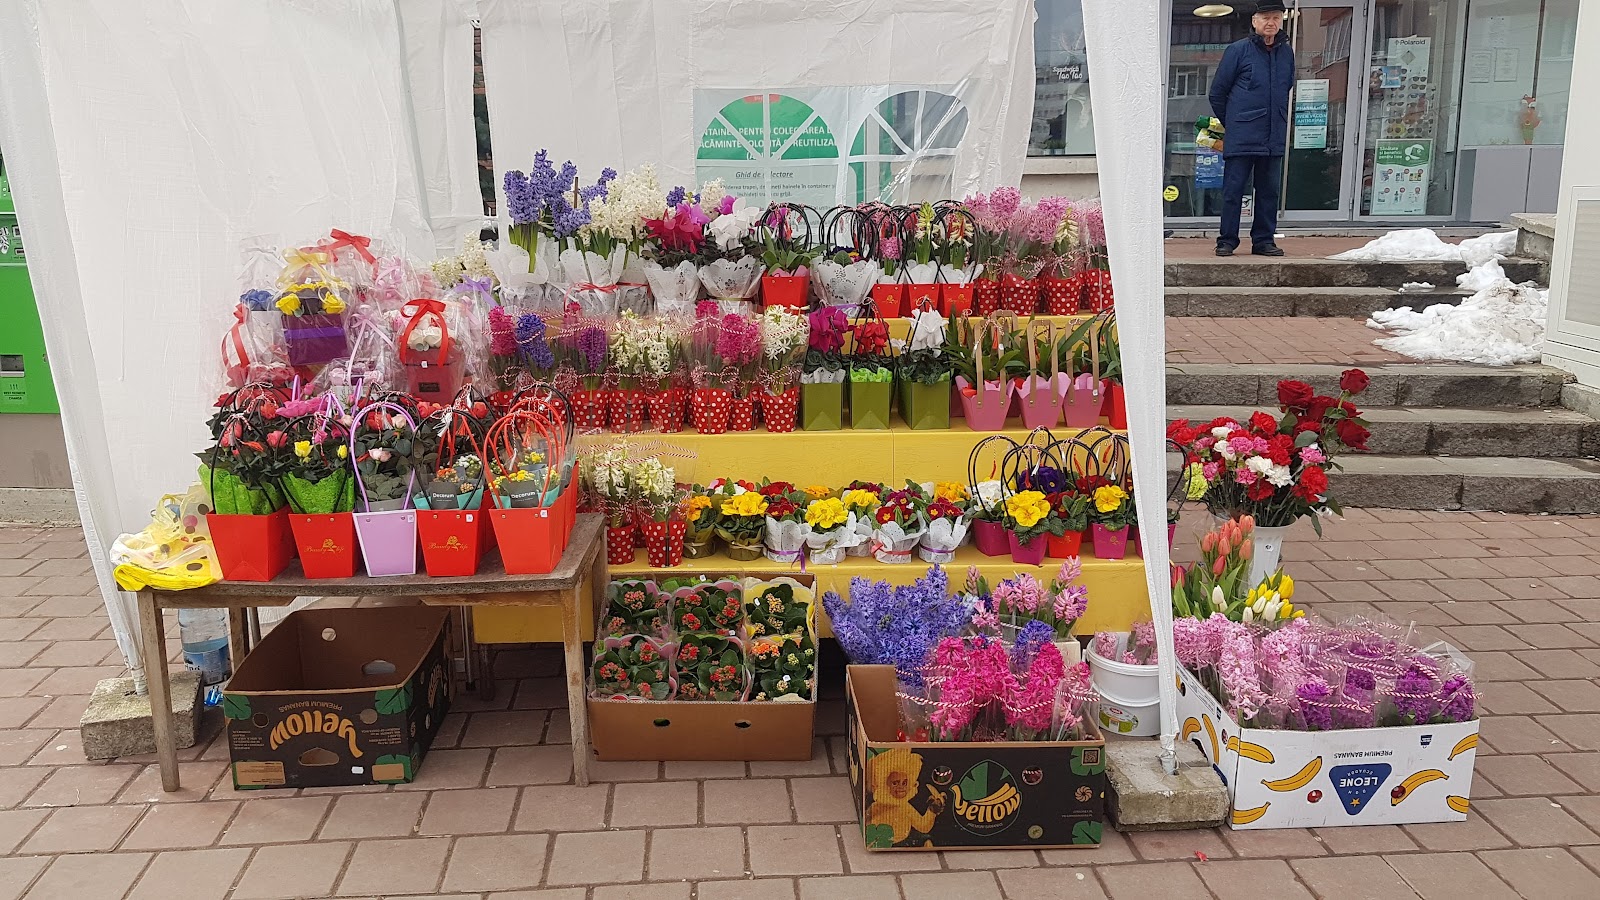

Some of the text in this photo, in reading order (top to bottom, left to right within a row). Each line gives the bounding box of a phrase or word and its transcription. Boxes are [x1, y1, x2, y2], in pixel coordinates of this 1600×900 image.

[739, 127, 771, 136] PENTR
[773, 126, 825, 135] COLECAREA
[793, 138, 836, 147] REUTILIZA
[735, 171, 751, 179] Ghid
[752, 171, 761, 179] de
[511, 490, 536, 499] Decorum
[279, 700, 343, 712] PREMIUM BANANAS
[270, 711, 363, 758] yellow
[1363, 750, 1393, 758] PREMIUM
[1339, 776, 1378, 787] LEONE
[952, 784, 1021, 823] yellow
